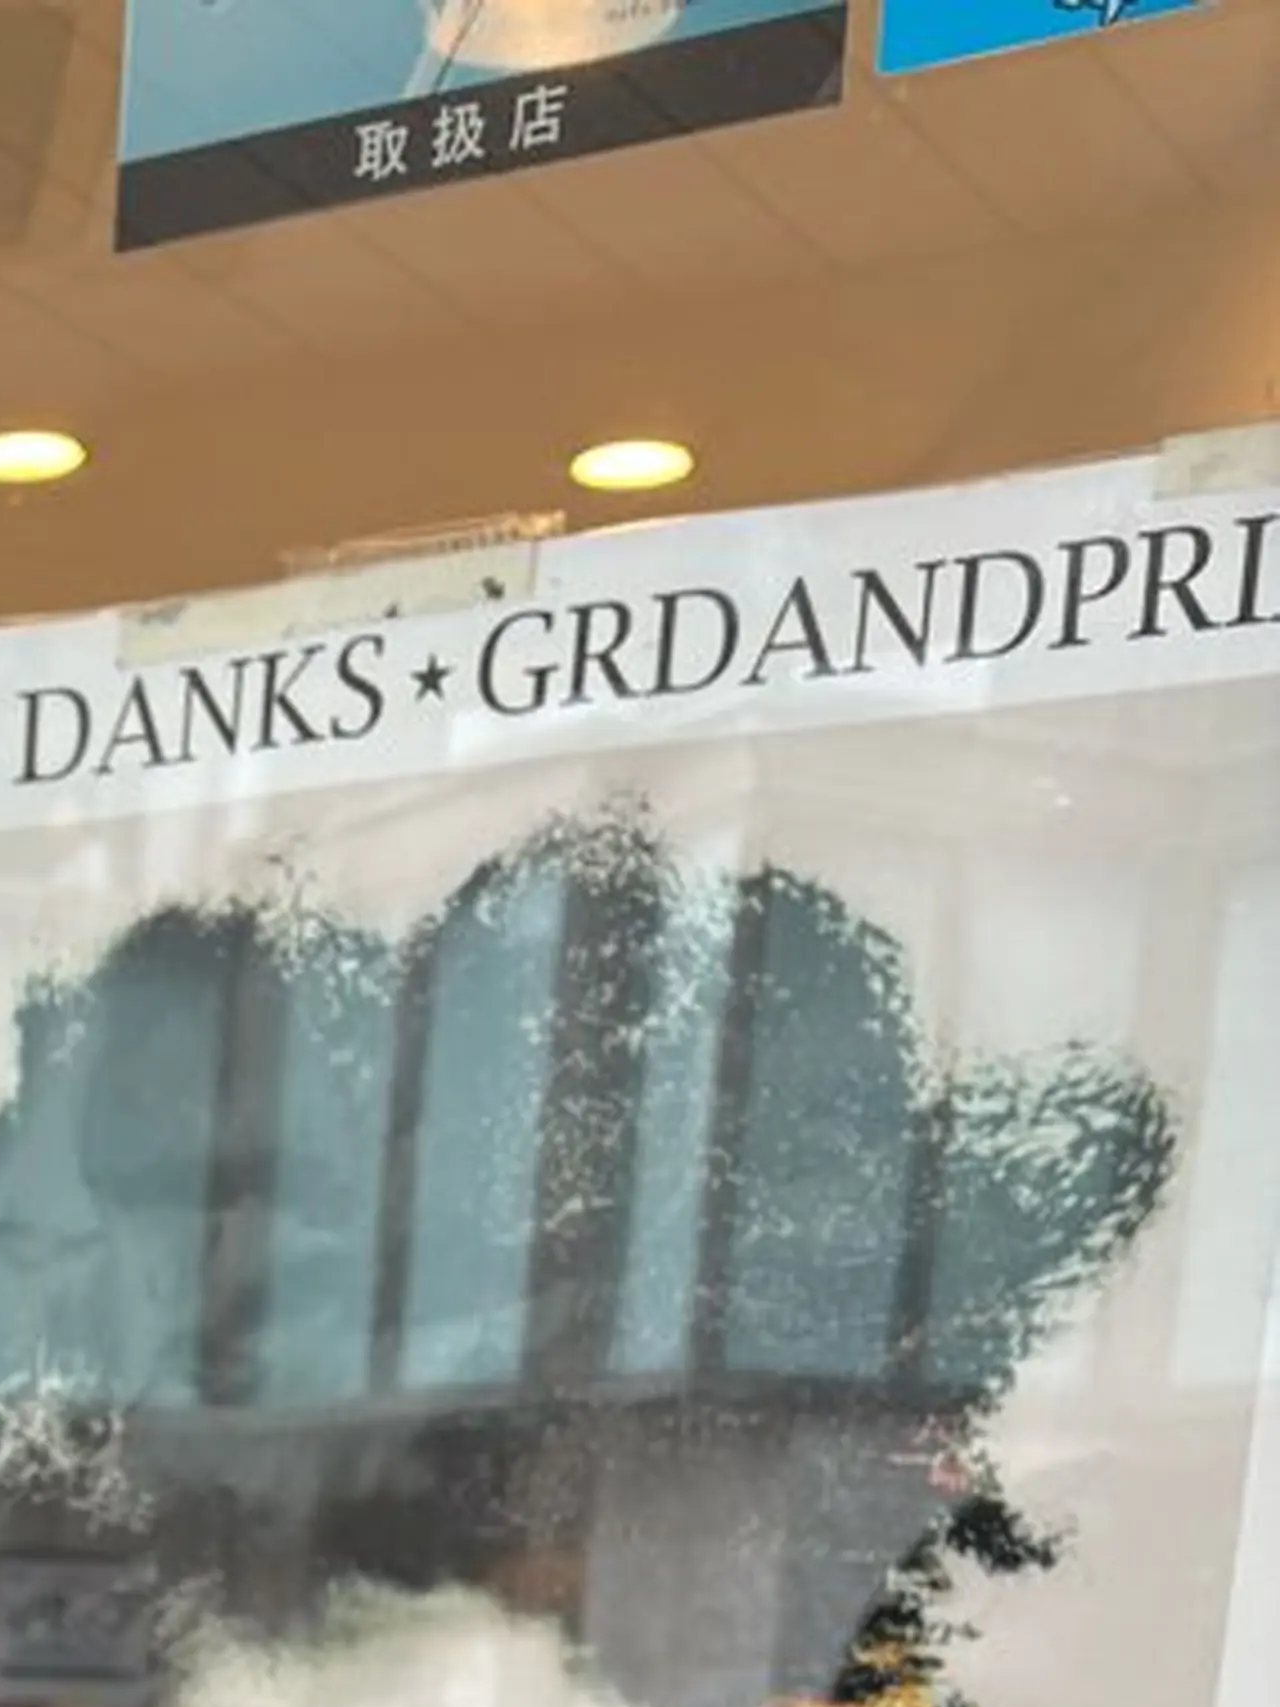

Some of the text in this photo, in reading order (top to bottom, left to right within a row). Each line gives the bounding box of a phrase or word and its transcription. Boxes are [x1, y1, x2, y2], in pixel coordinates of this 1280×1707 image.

[353, 84, 569, 181] 取扱店
[13, 633, 387, 787] DANKS
[476, 511, 1280, 717] GRDANDPRI
